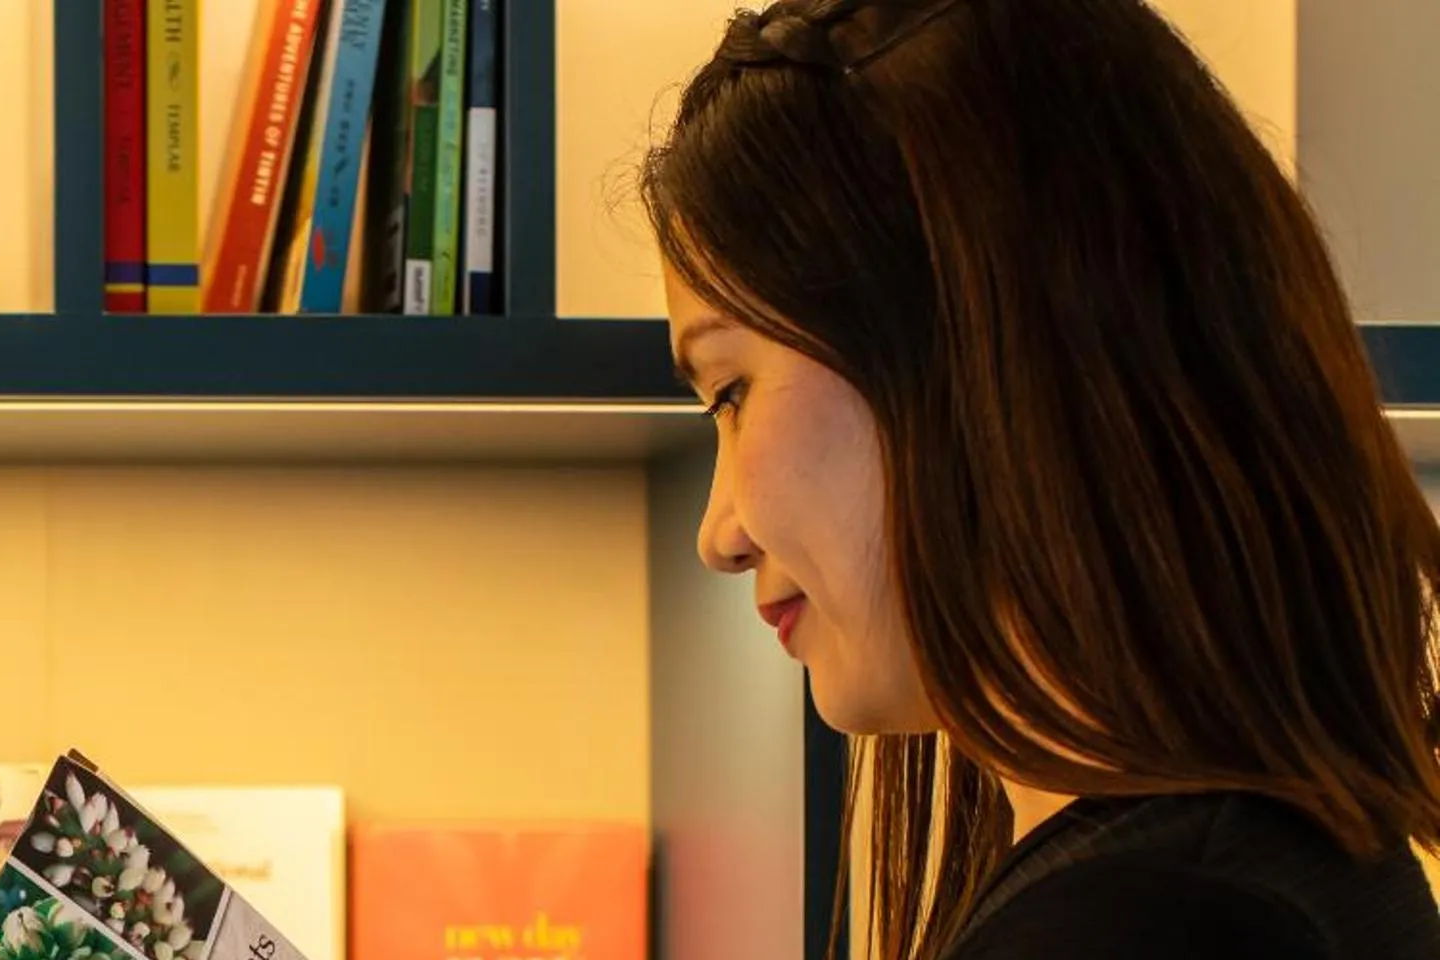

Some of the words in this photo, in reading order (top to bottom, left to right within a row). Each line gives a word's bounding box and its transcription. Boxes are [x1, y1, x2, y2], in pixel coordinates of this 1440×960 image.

[164, 0, 183, 43] LTH
[268, 22, 305, 122] ADVENTURES
[264, 125, 282, 147] OF
[250, 151, 277, 206] TINTIN
[444, 923, 515, 949] new
[521, 911, 584, 956] day
